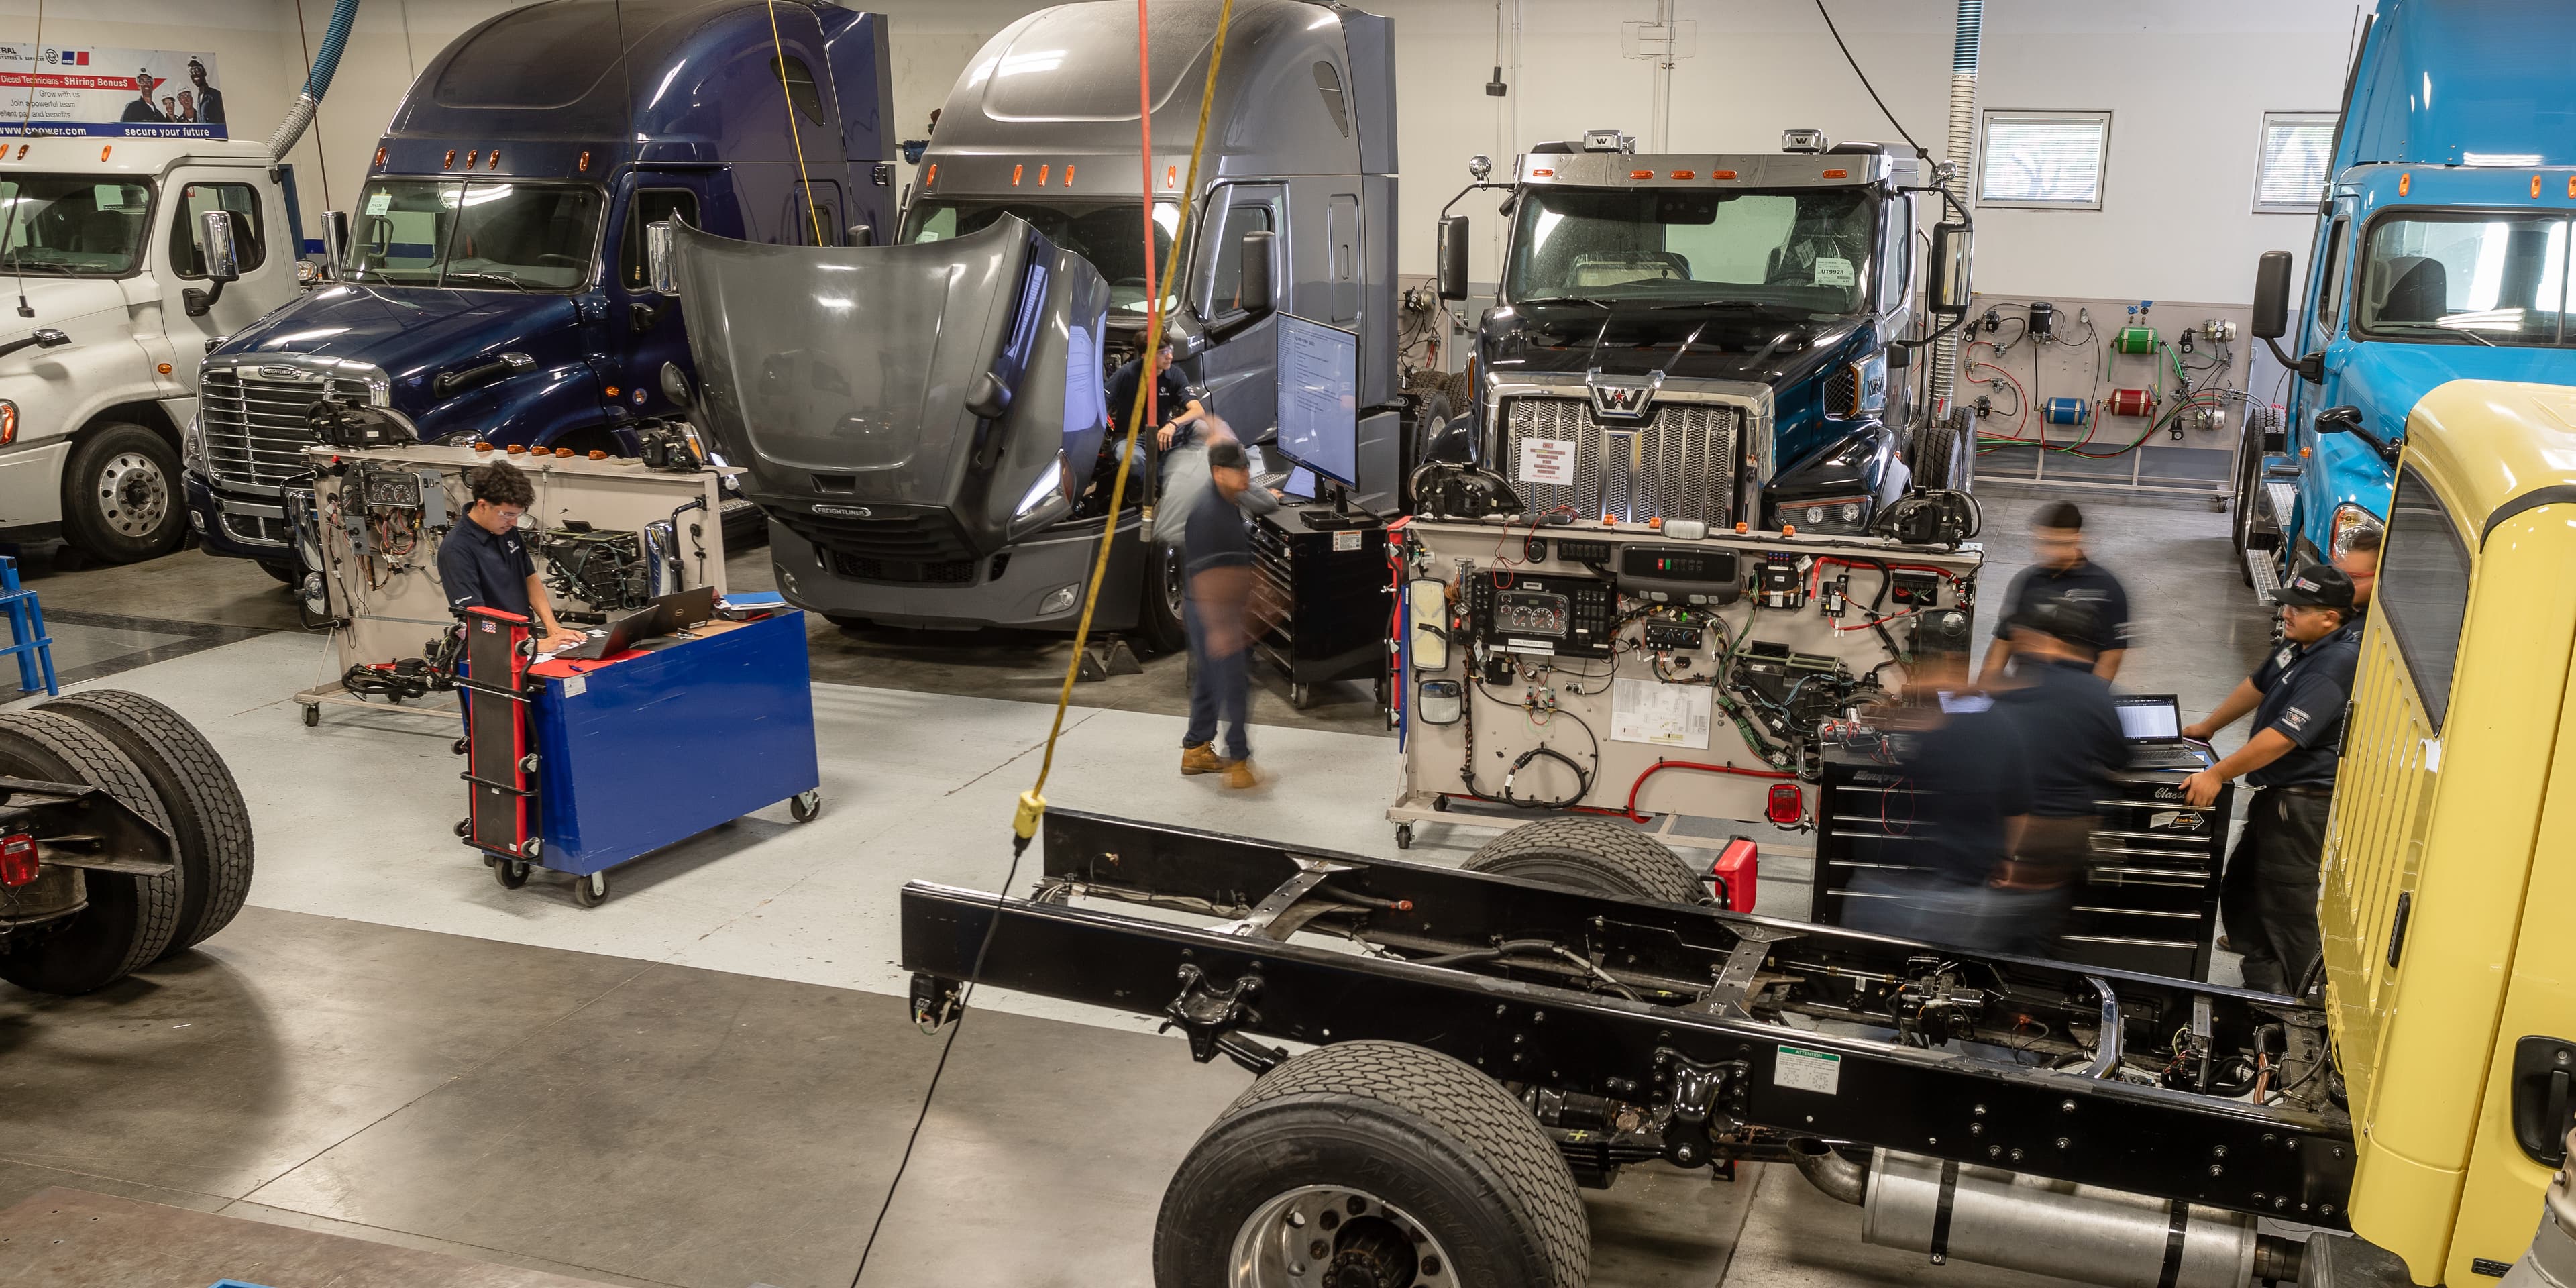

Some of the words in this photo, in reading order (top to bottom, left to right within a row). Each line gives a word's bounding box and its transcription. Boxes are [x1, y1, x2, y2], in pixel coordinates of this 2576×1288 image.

[1, 75, 21, 83] Diesel
[64, 76, 95, 87] $Hiring
[97, 78, 128, 87] Bonus$
[160, 128, 179, 138] your
[182, 127, 210, 136] future
[2155, 787, 2187, 800] Classi
[1794, 1050, 1823, 1059] ATTENTION
